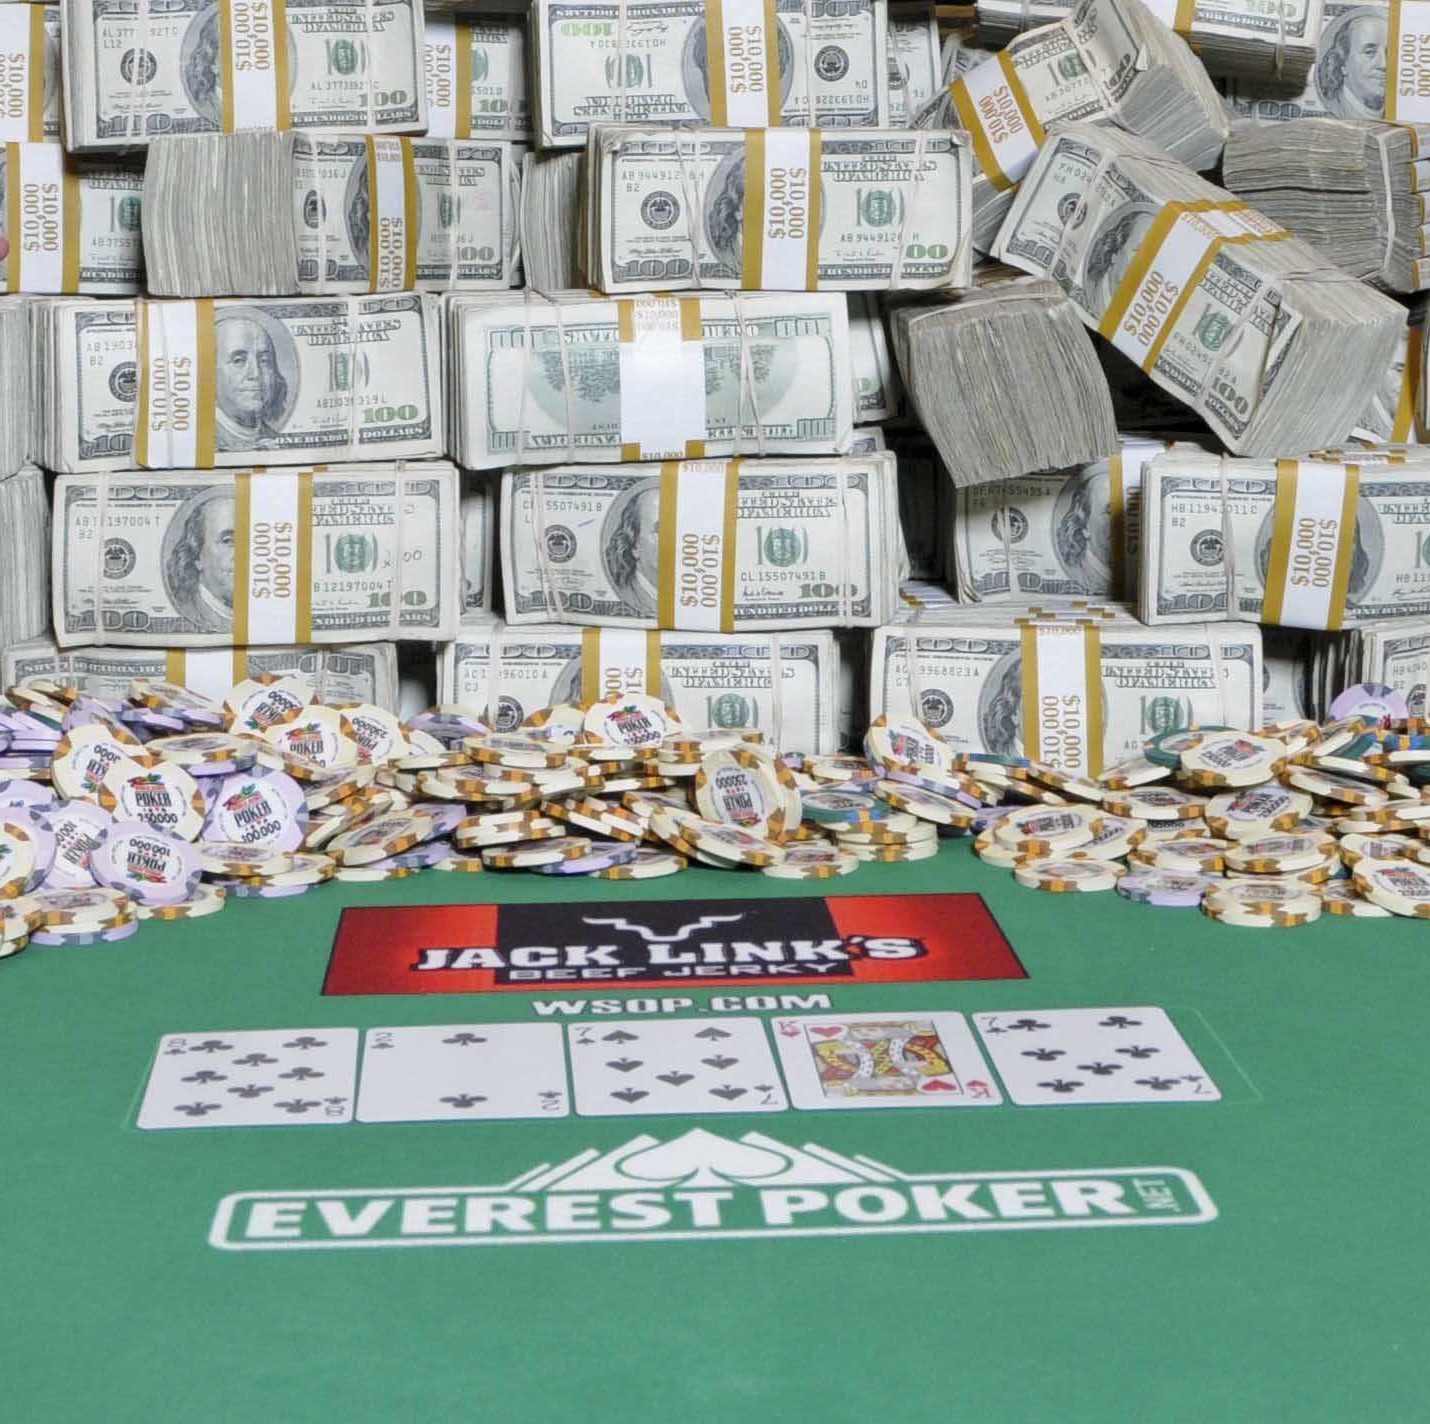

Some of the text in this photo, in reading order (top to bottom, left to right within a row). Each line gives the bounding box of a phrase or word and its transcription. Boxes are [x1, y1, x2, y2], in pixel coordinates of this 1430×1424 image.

[234, 2, 252, 71] $10,000
[252, 1, 269, 71] $10,000
[728, 26, 747, 94] $10,000
[747, 26, 764, 93] $10,000
[1399, 34, 1417, 97] $10,000
[8, 53, 25, 118] $10,000
[435, 43, 452, 108] $10,000
[978, 95, 1009, 144] $10,000
[992, 84, 1024, 136] $10,000
[24, 184, 40, 252] $10,000
[42, 183, 59, 252] $10,000
[768, 167, 788, 240] $10,000
[788, 167, 808, 239] $10,000
[379, 217, 391, 288] $10,000
[391, 216, 403, 288] $10,000
[1122, 270, 1165, 337] $10,000
[1138, 280, 1180, 348] $10,000
[172, 356, 192, 431] $10,000
[363, 405, 418, 423] 100
[252, 522, 272, 599] $10,000
[273, 522, 292, 599] $10,000
[681, 533, 699, 607] $10,000
[700, 534, 721, 608] $10,000
[1289, 515, 1320, 587] $10,000
[1312, 518, 1338, 589] $10,000
[416, 936, 921, 970] JACK LINK'S
[509, 962, 844, 981] BEEF JERKY
[374, 1031, 393, 1042] 2
[531, 993, 832, 1017] WSOP.COM
[574, 1026, 593, 1038] 7
[776, 1019, 799, 1031] K
[980, 1016, 999, 1027] 7
[539, 1098, 561, 1111] 2
[760, 1092, 780, 1105] 7
[970, 1086, 995, 1099] K
[1193, 1082, 1212, 1095] 7
[242, 1182, 734, 1242] EVEREST
[759, 1178, 1136, 1228] POKER
